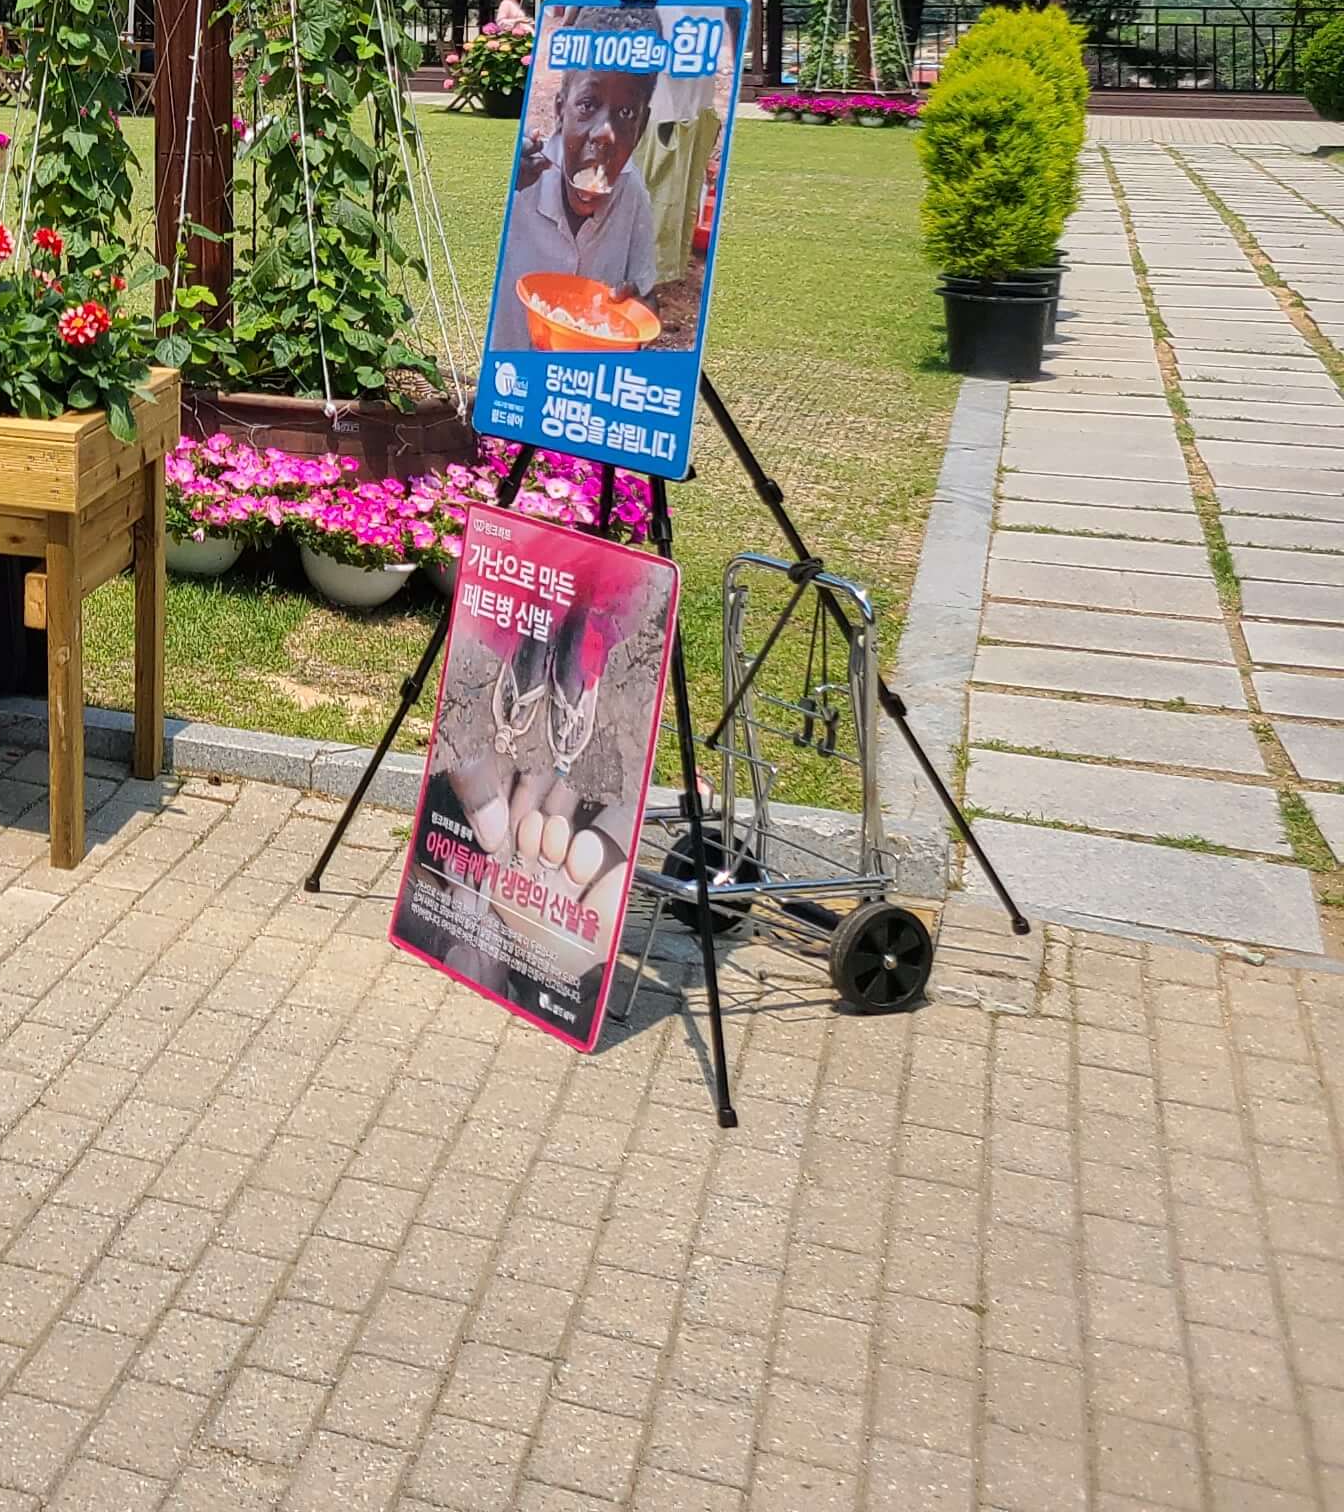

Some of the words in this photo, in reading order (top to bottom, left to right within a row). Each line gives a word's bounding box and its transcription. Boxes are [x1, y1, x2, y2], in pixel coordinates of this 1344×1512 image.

[550, 33, 589, 66] 한끼
[594, 35, 666, 68] 100원의
[672, 21, 720, 73] 힘!
[545, 364, 595, 399] 당신의
[595, 364, 682, 417] 나눔으로
[541, 396, 606, 445] 생명을
[606, 421, 677, 461] 살립니다
[468, 544, 535, 590] 가난으로
[539, 566, 576, 607] 만든
[462, 583, 514, 628] 페트병
[515, 602, 553, 642] 신발
[426, 831, 500, 890] 아이들에게
[501, 868, 548, 917] 생명의
[549, 893, 600, 943] 신발을
